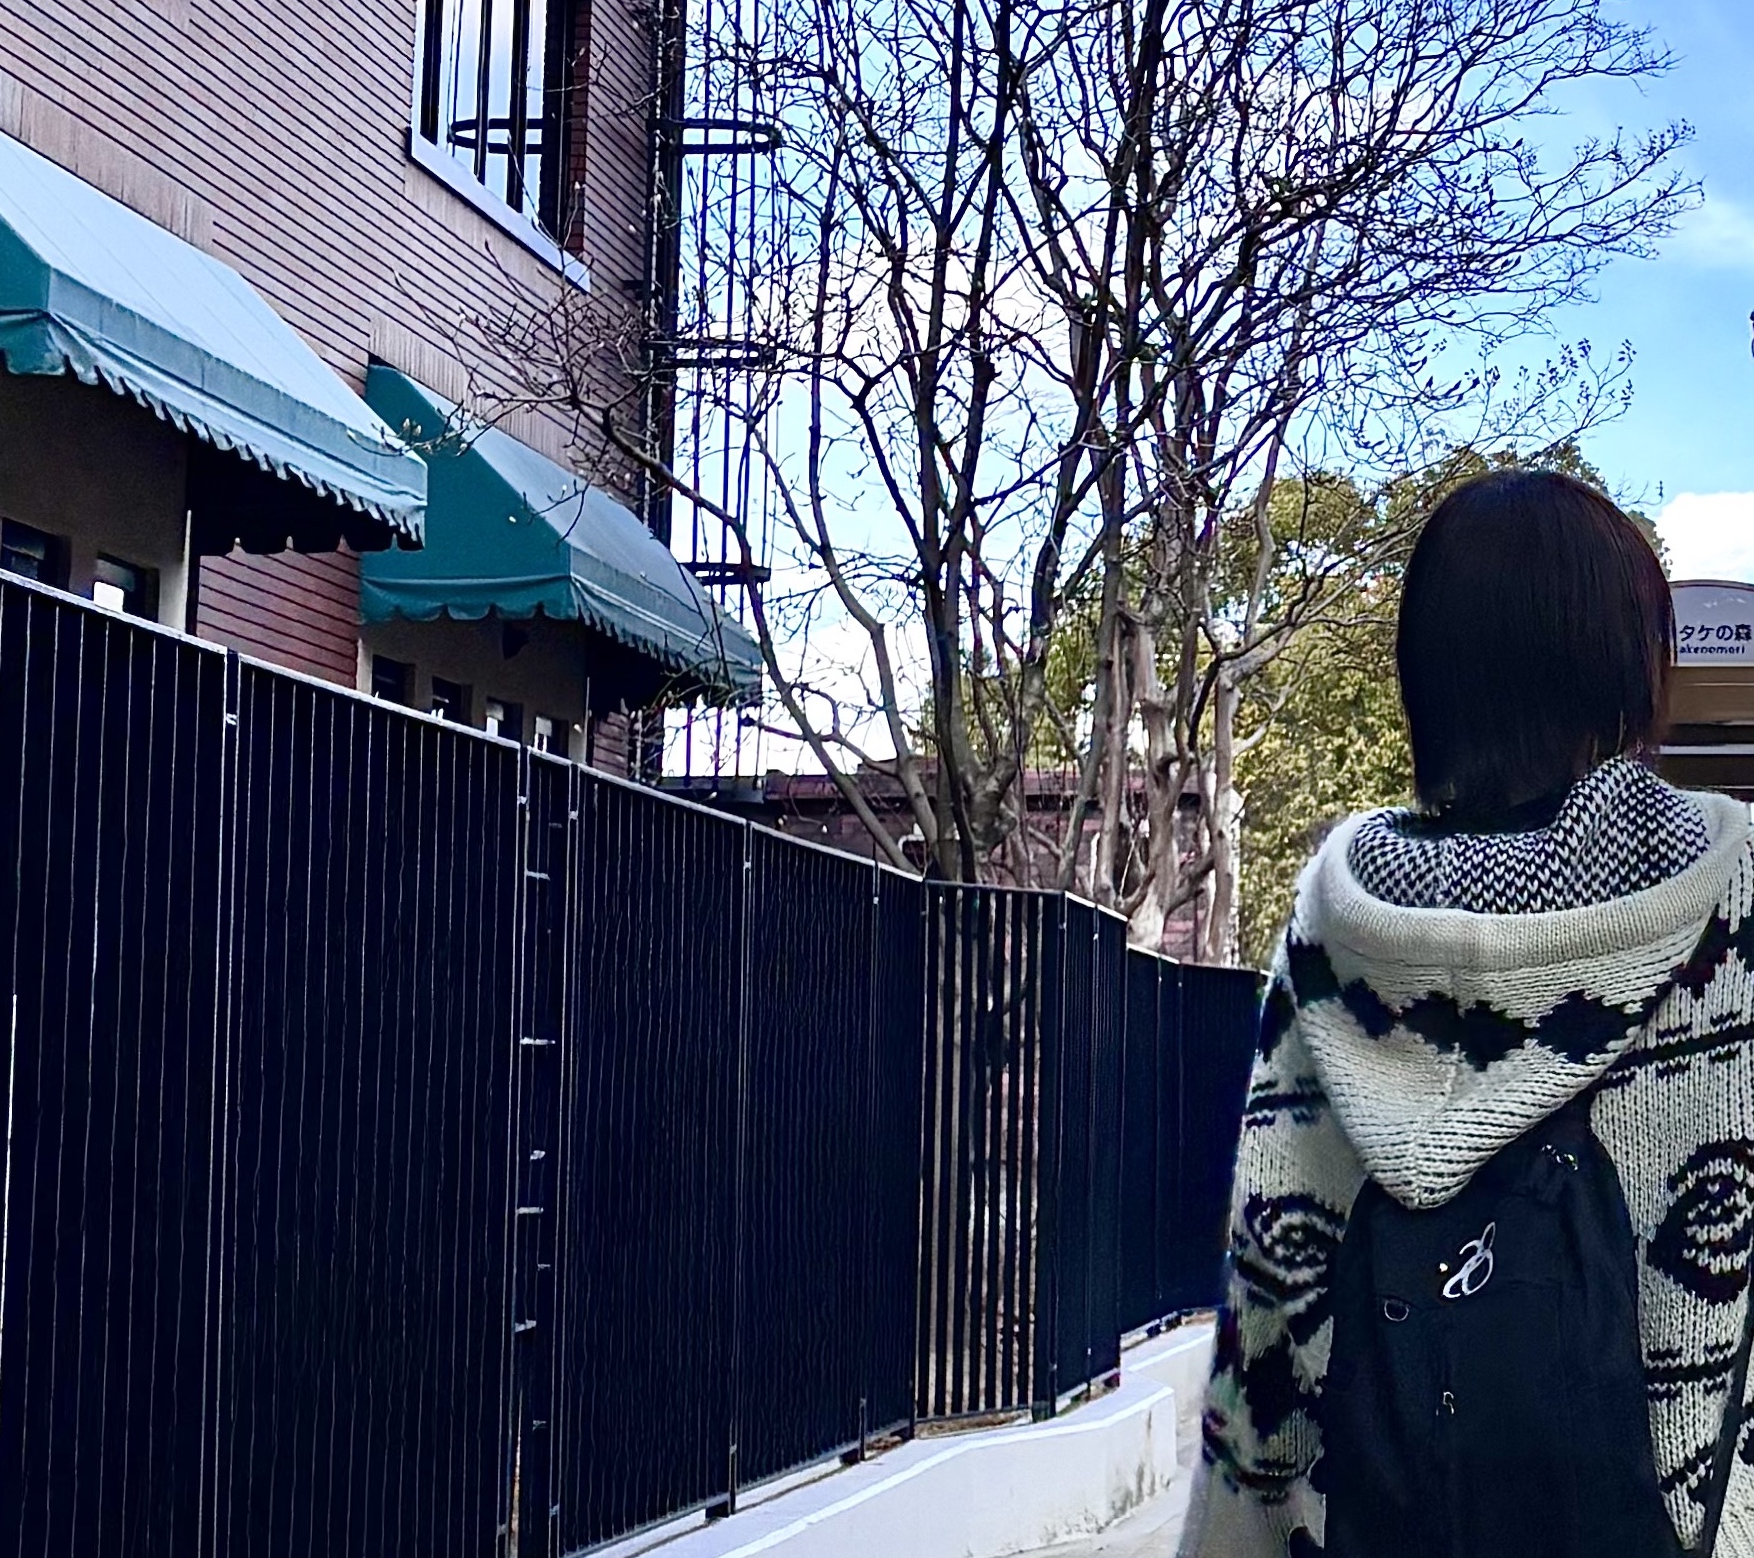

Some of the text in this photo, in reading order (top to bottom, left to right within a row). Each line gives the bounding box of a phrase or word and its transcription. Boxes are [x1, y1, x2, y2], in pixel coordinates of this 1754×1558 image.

[1679, 624, 1752, 642] タケの森
[1679, 643, 1746, 655] akenomori
